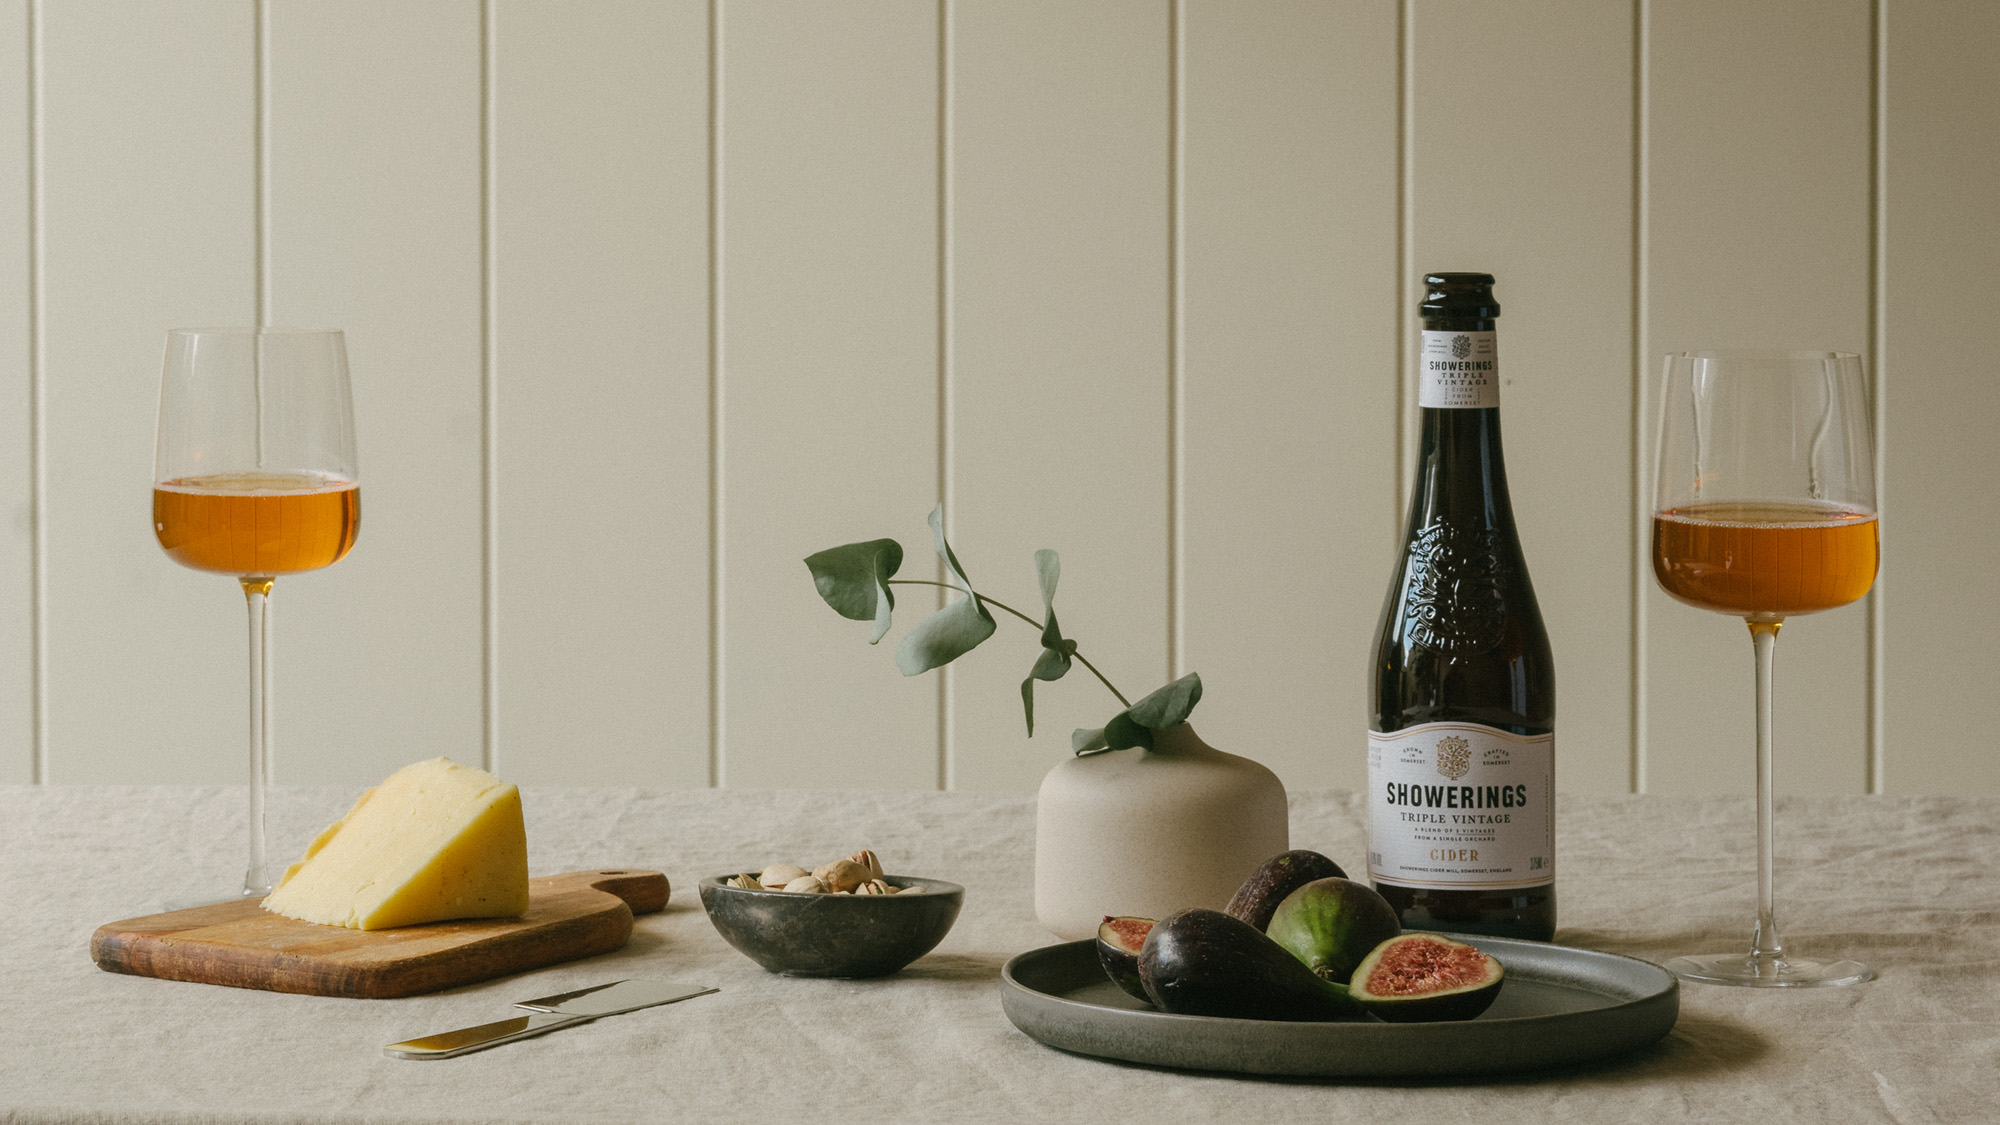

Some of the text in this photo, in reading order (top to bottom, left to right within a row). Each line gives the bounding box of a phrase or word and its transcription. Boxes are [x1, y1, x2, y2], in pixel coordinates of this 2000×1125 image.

[1429, 360, 1493, 371] SHOWERINGS
[1402, 746, 1423, 755] GROWN
[1483, 748, 1511, 757] CRAFTED
[1386, 781, 1527, 809] SHOWERINGS
[1400, 812, 1511, 824] TRIPLE VINTAGE
[1429, 848, 1479, 862] CIDER
